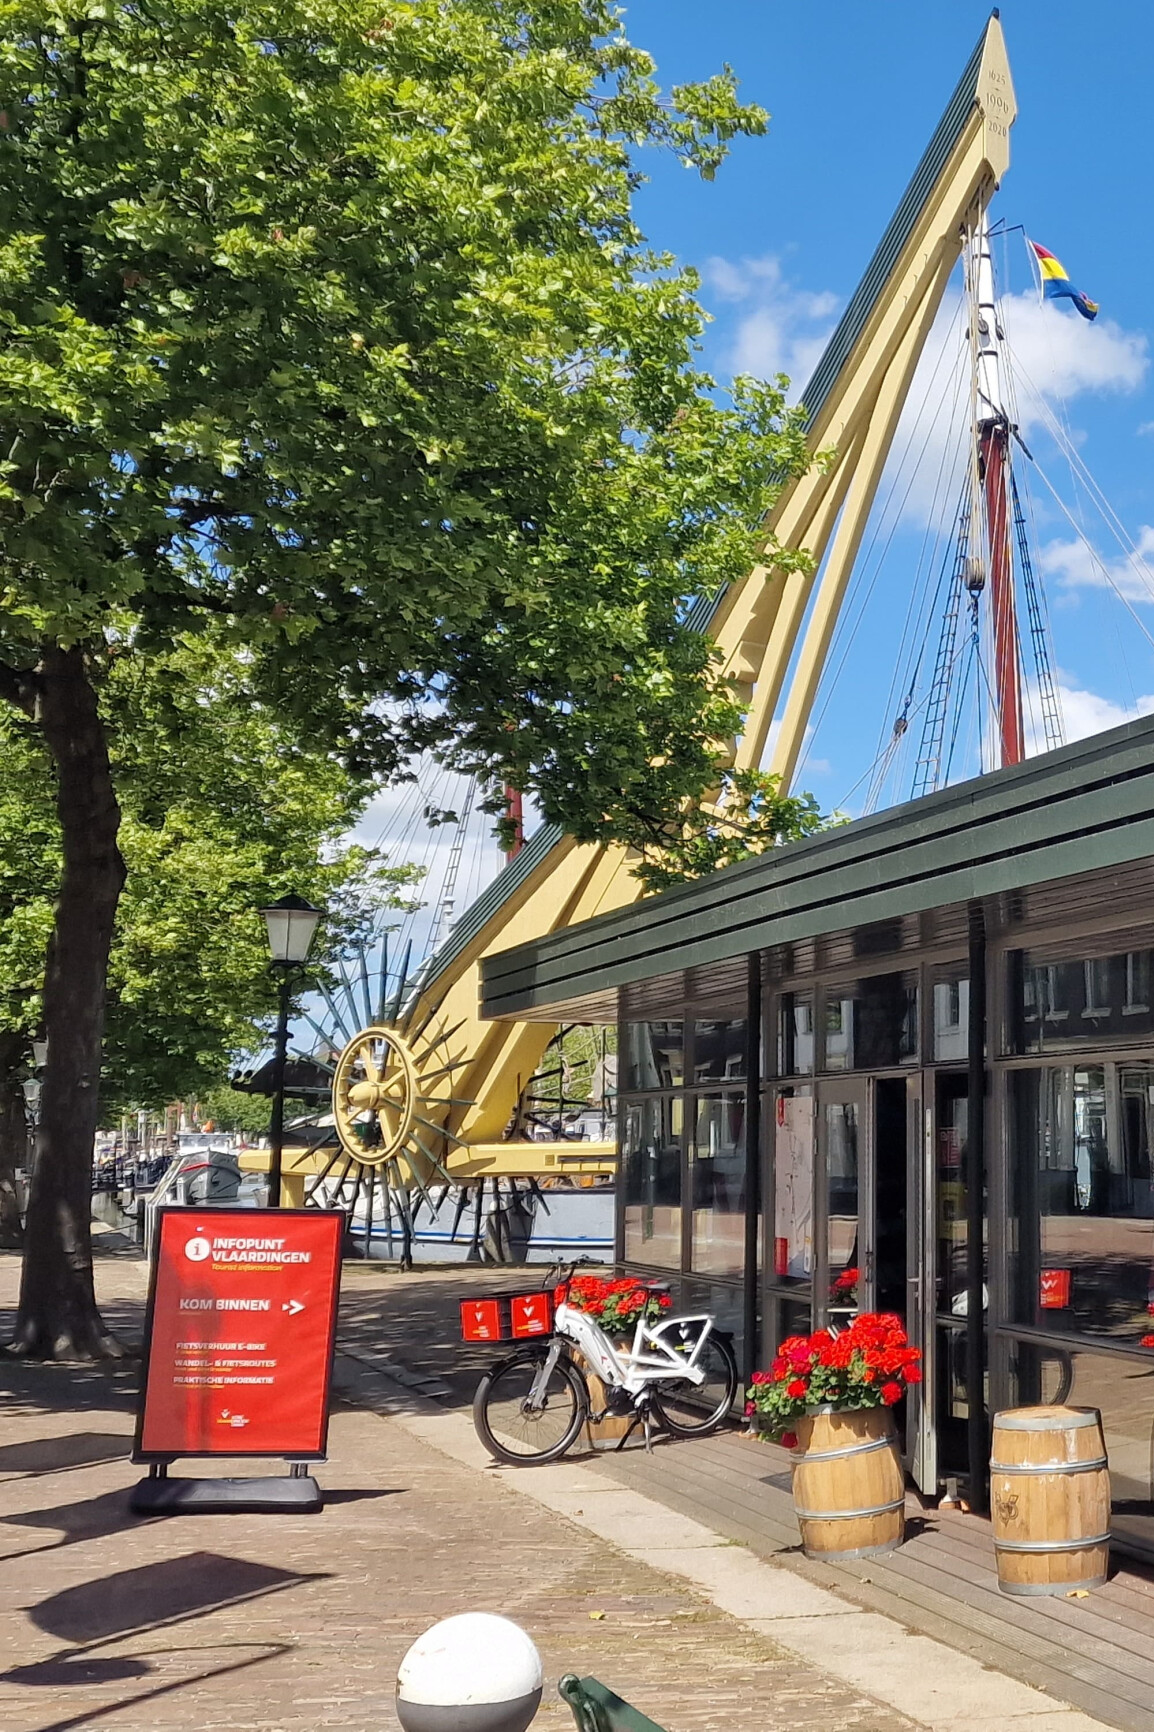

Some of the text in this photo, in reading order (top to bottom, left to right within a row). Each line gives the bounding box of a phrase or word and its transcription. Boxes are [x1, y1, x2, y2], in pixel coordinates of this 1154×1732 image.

[988, 69, 1006, 86] 1625
[988, 120, 1007, 137] 2020
[212, 1238, 286, 1250] INFOPUNT
[211, 1250, 312, 1263] VLAARDINGEN
[179, 1299, 271, 1311] KOM BINNEN
